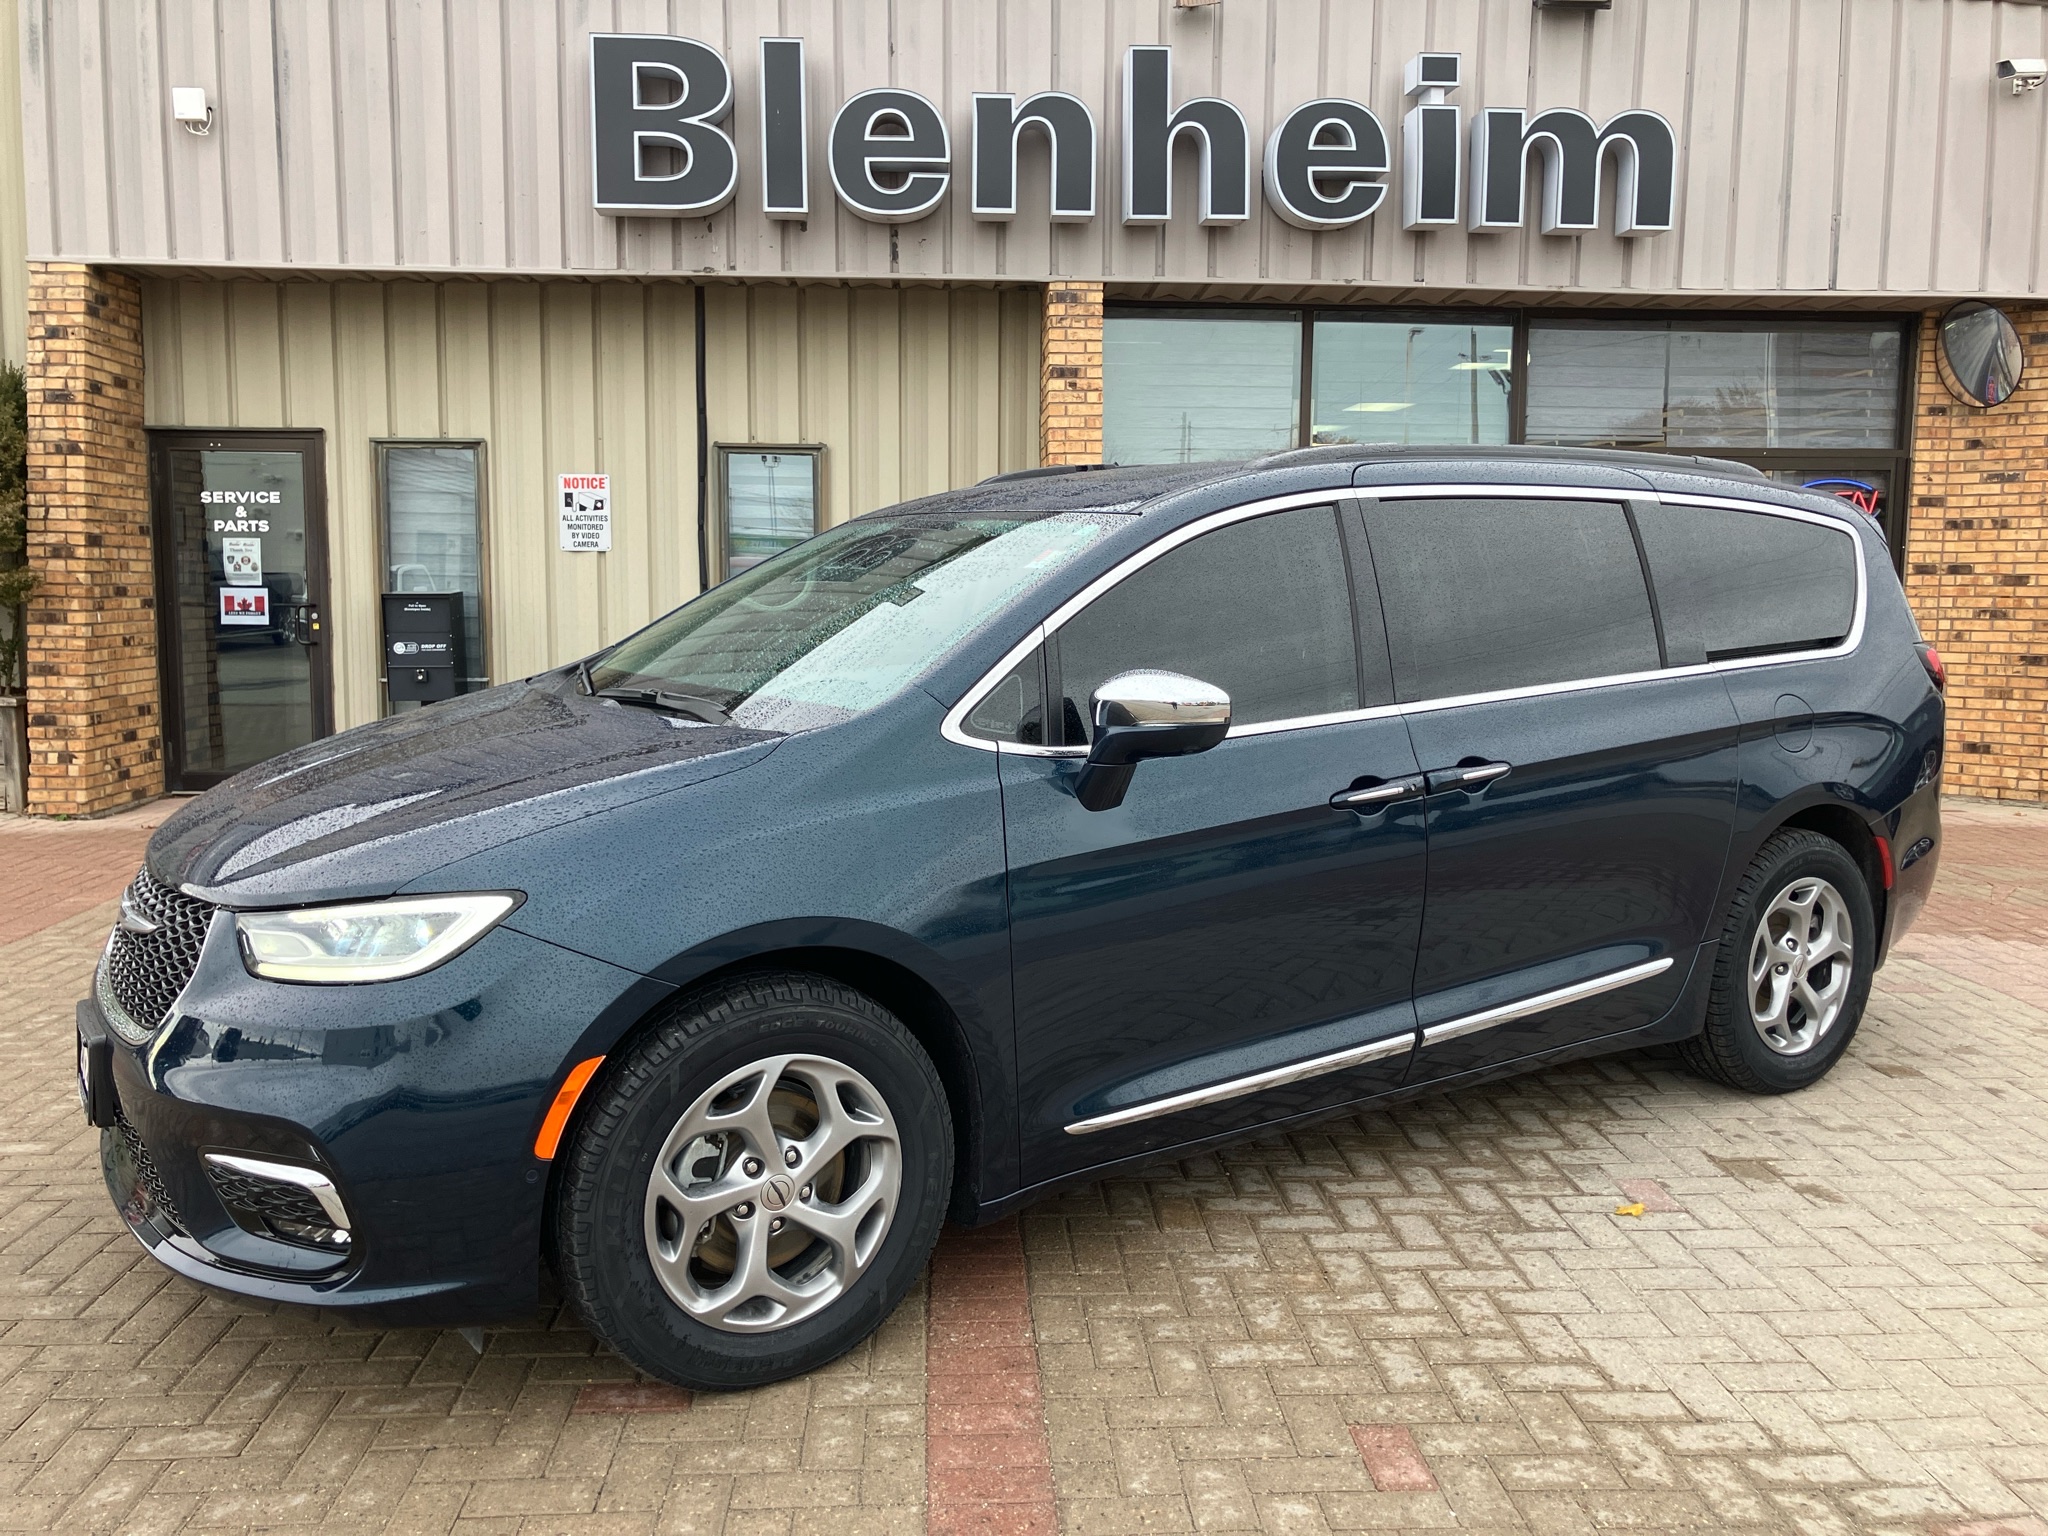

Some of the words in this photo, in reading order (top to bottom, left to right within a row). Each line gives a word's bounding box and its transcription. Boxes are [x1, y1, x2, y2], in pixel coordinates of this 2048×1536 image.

[589, 32, 1678, 238] Blenheim
[563, 477, 606, 490] NOTICE
[200, 490, 281, 504] SERVICE
[235, 505, 247, 518] &
[562, 514, 574, 522] ALL
[575, 514, 609, 522] ACTIVITIES
[213, 519, 270, 533] PARTS
[567, 523, 604, 531] MONITORED
[758, 1015, 806, 1034] EDGE
[815, 1018, 879, 1048] TOURING
